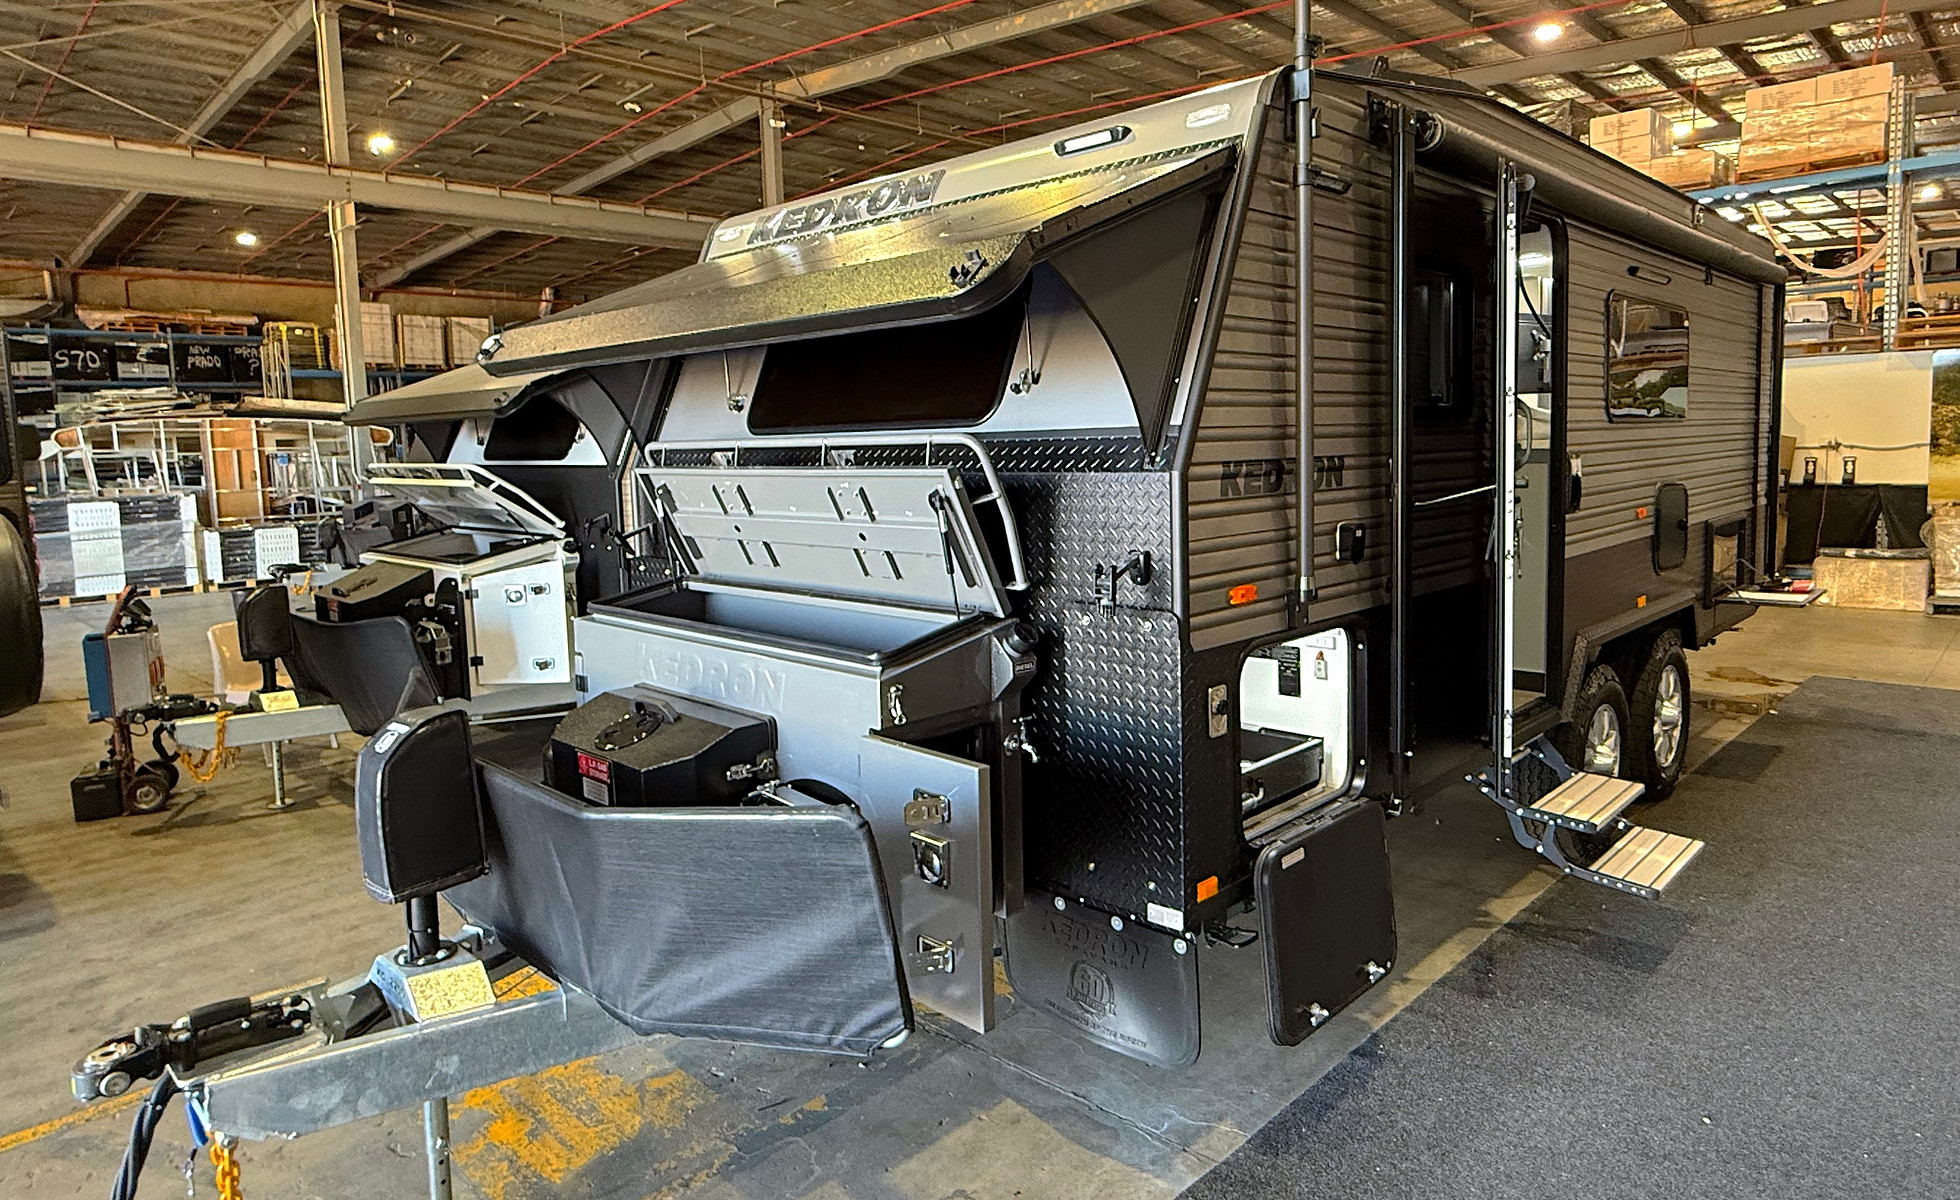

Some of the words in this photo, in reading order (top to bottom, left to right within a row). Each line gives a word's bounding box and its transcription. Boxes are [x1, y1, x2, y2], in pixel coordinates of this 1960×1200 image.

[747, 168, 947, 246] KEDRON
[187, 355, 222, 369] PRADO
[189, 345, 210, 355] NEW
[636, 641, 787, 712] KEDRON
[1041, 909, 1149, 969] KEDRON
